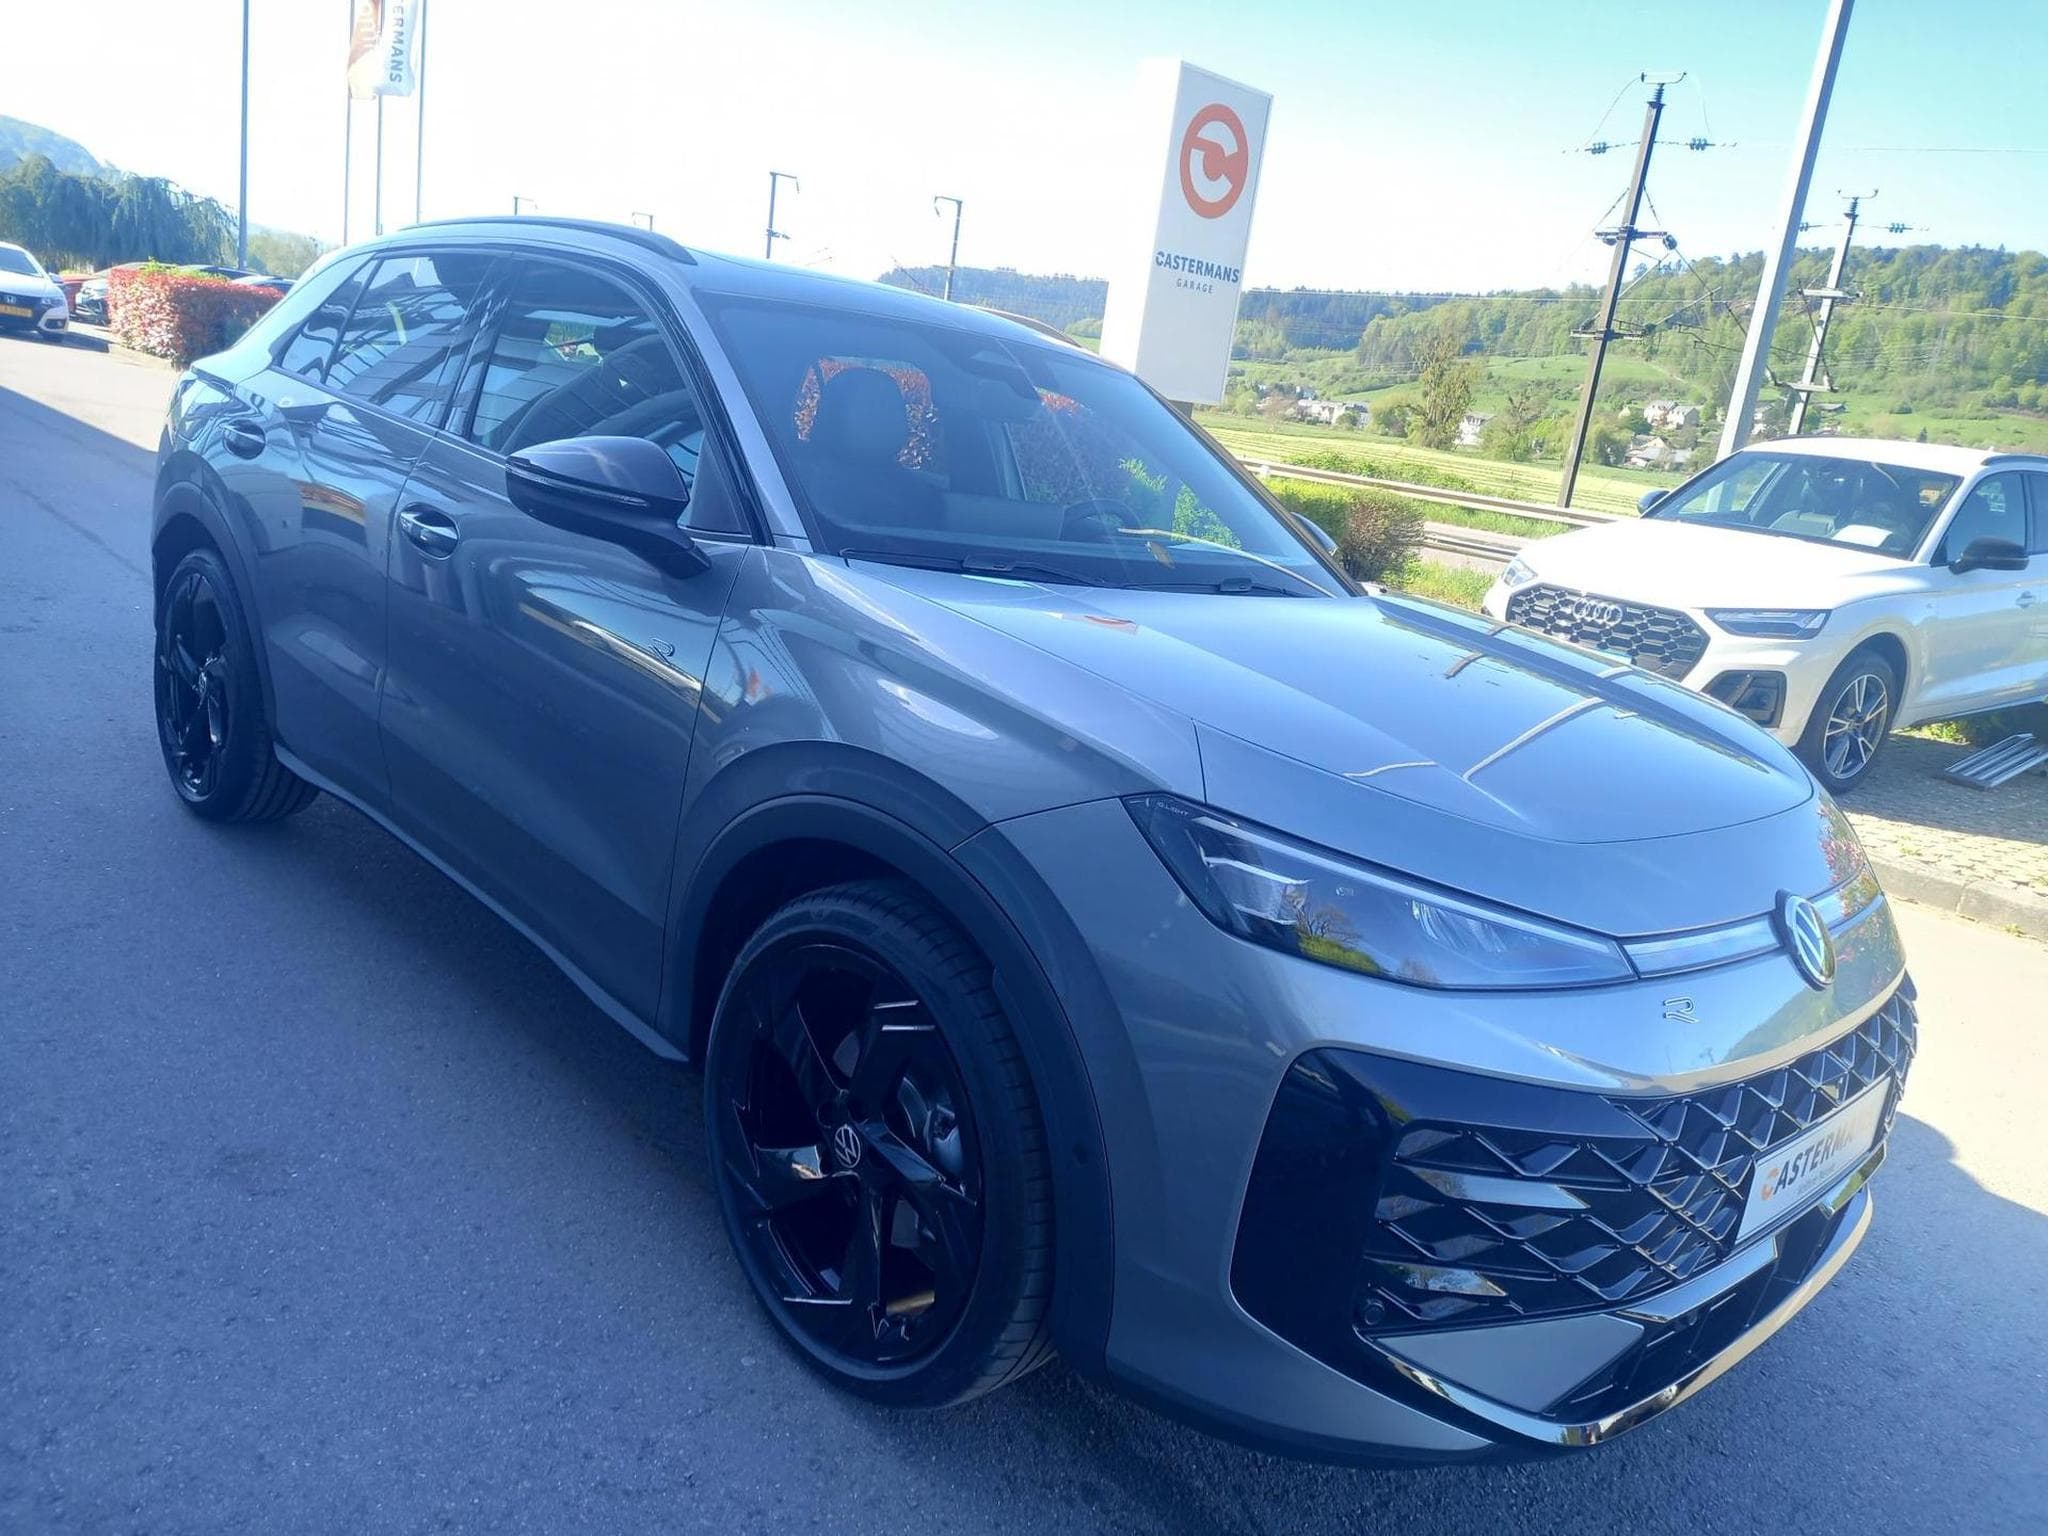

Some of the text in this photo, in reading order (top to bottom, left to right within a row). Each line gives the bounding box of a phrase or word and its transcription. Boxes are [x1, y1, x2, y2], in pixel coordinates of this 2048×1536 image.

[1154, 250, 1240, 284] CASTERMANS
[1176, 278, 1214, 294] GARAGE
[1663, 996, 1700, 1024] R
